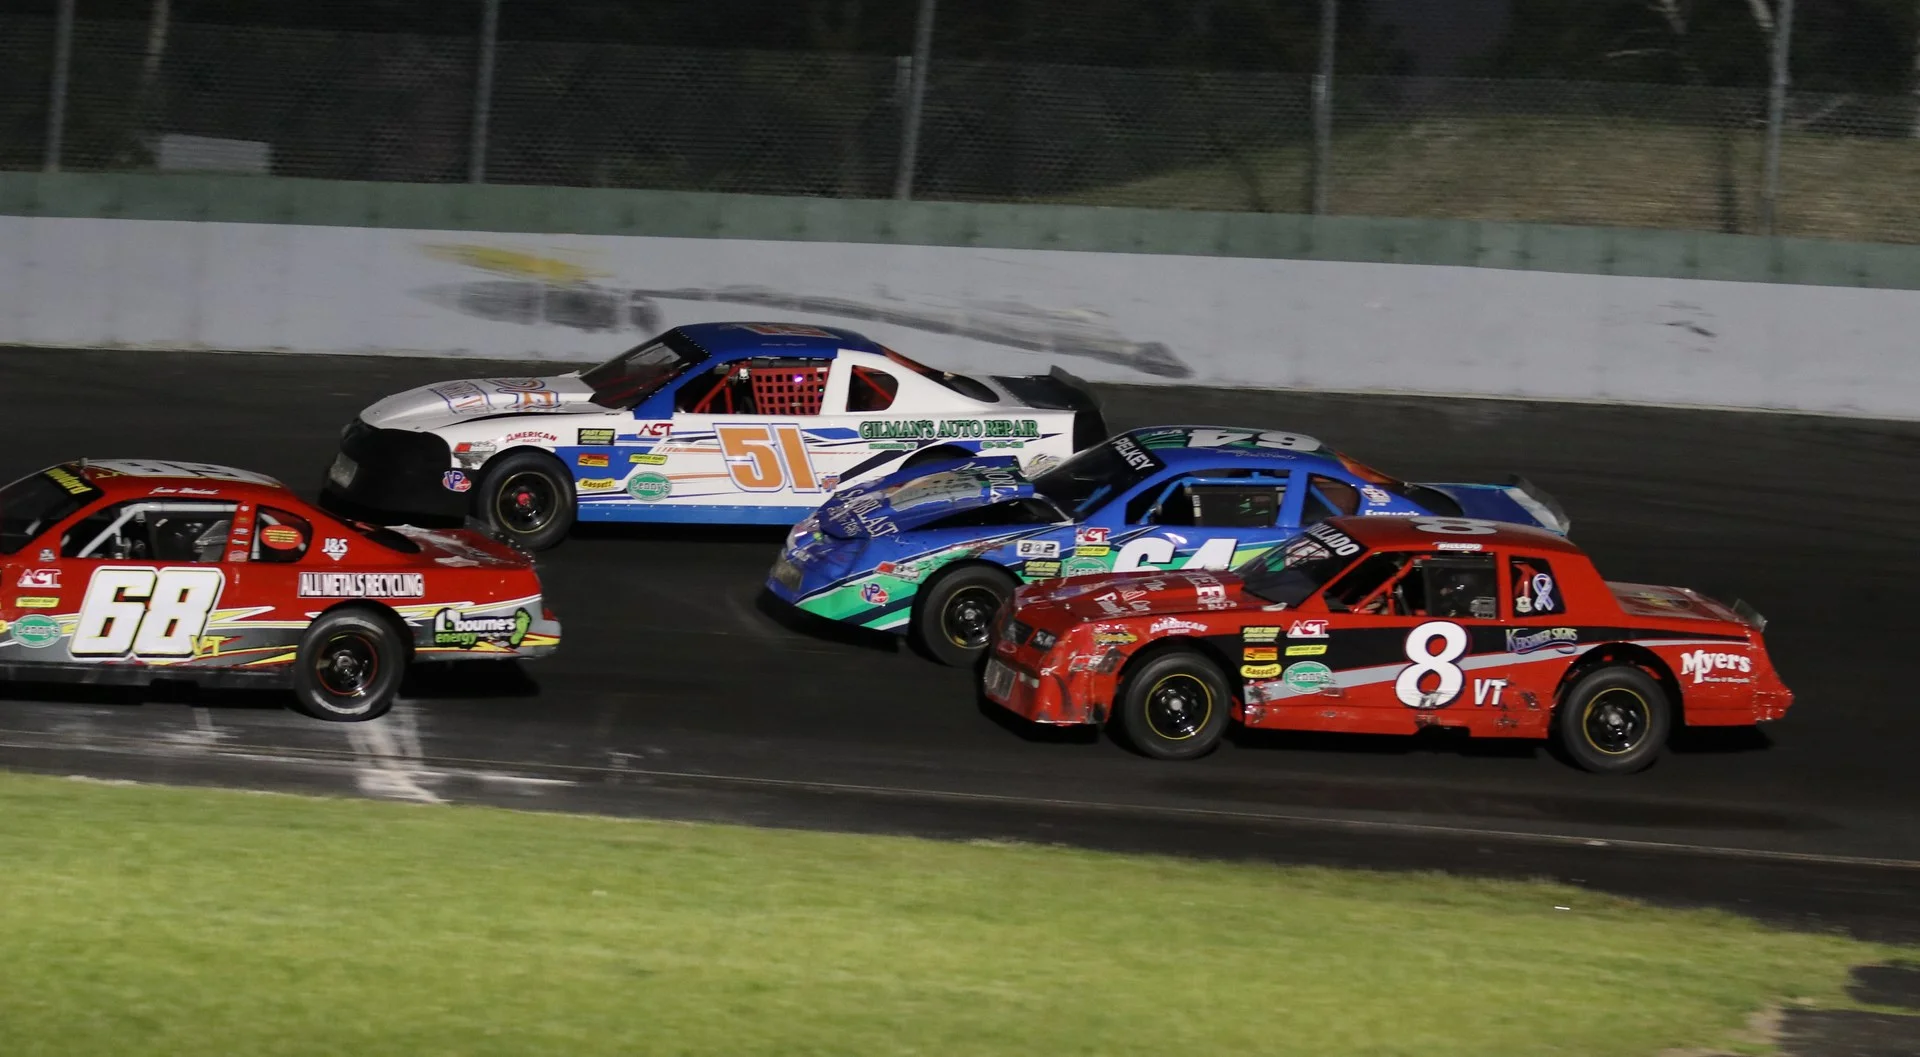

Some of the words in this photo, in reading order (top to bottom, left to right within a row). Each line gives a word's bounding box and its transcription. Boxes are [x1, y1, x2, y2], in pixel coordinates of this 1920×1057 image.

[506, 431, 557, 443] AMERICAN
[637, 423, 674, 437] ACT
[859, 420, 935, 439] GILMAN'S
[936, 420, 983, 438] AUTO
[984, 420, 1041, 438] REPAIR
[712, 422, 822, 494] 51
[1111, 437, 1155, 470] PELKEY
[444, 470, 465, 490] VP
[582, 480, 613, 489] Bassett
[630, 478, 671, 494] Lenny's
[321, 538, 348, 553] J&S
[17, 568, 62, 588] ACT
[300, 573, 322, 597] ALL
[322, 573, 365, 597] METALS
[365, 573, 424, 597] RECYCLING
[67, 565, 226, 662] 68
[15, 622, 60, 639] Lenny's
[1150, 620, 1208, 634] AMERICAN
[1286, 619, 1329, 638] ACT
[191, 635, 227, 657] VT
[435, 633, 477, 645] energy
[1245, 666, 1277, 676] Bassett
[1395, 620, 1468, 709] 8
[1679, 649, 1752, 684] Myers
[1474, 678, 1508, 706] VT
